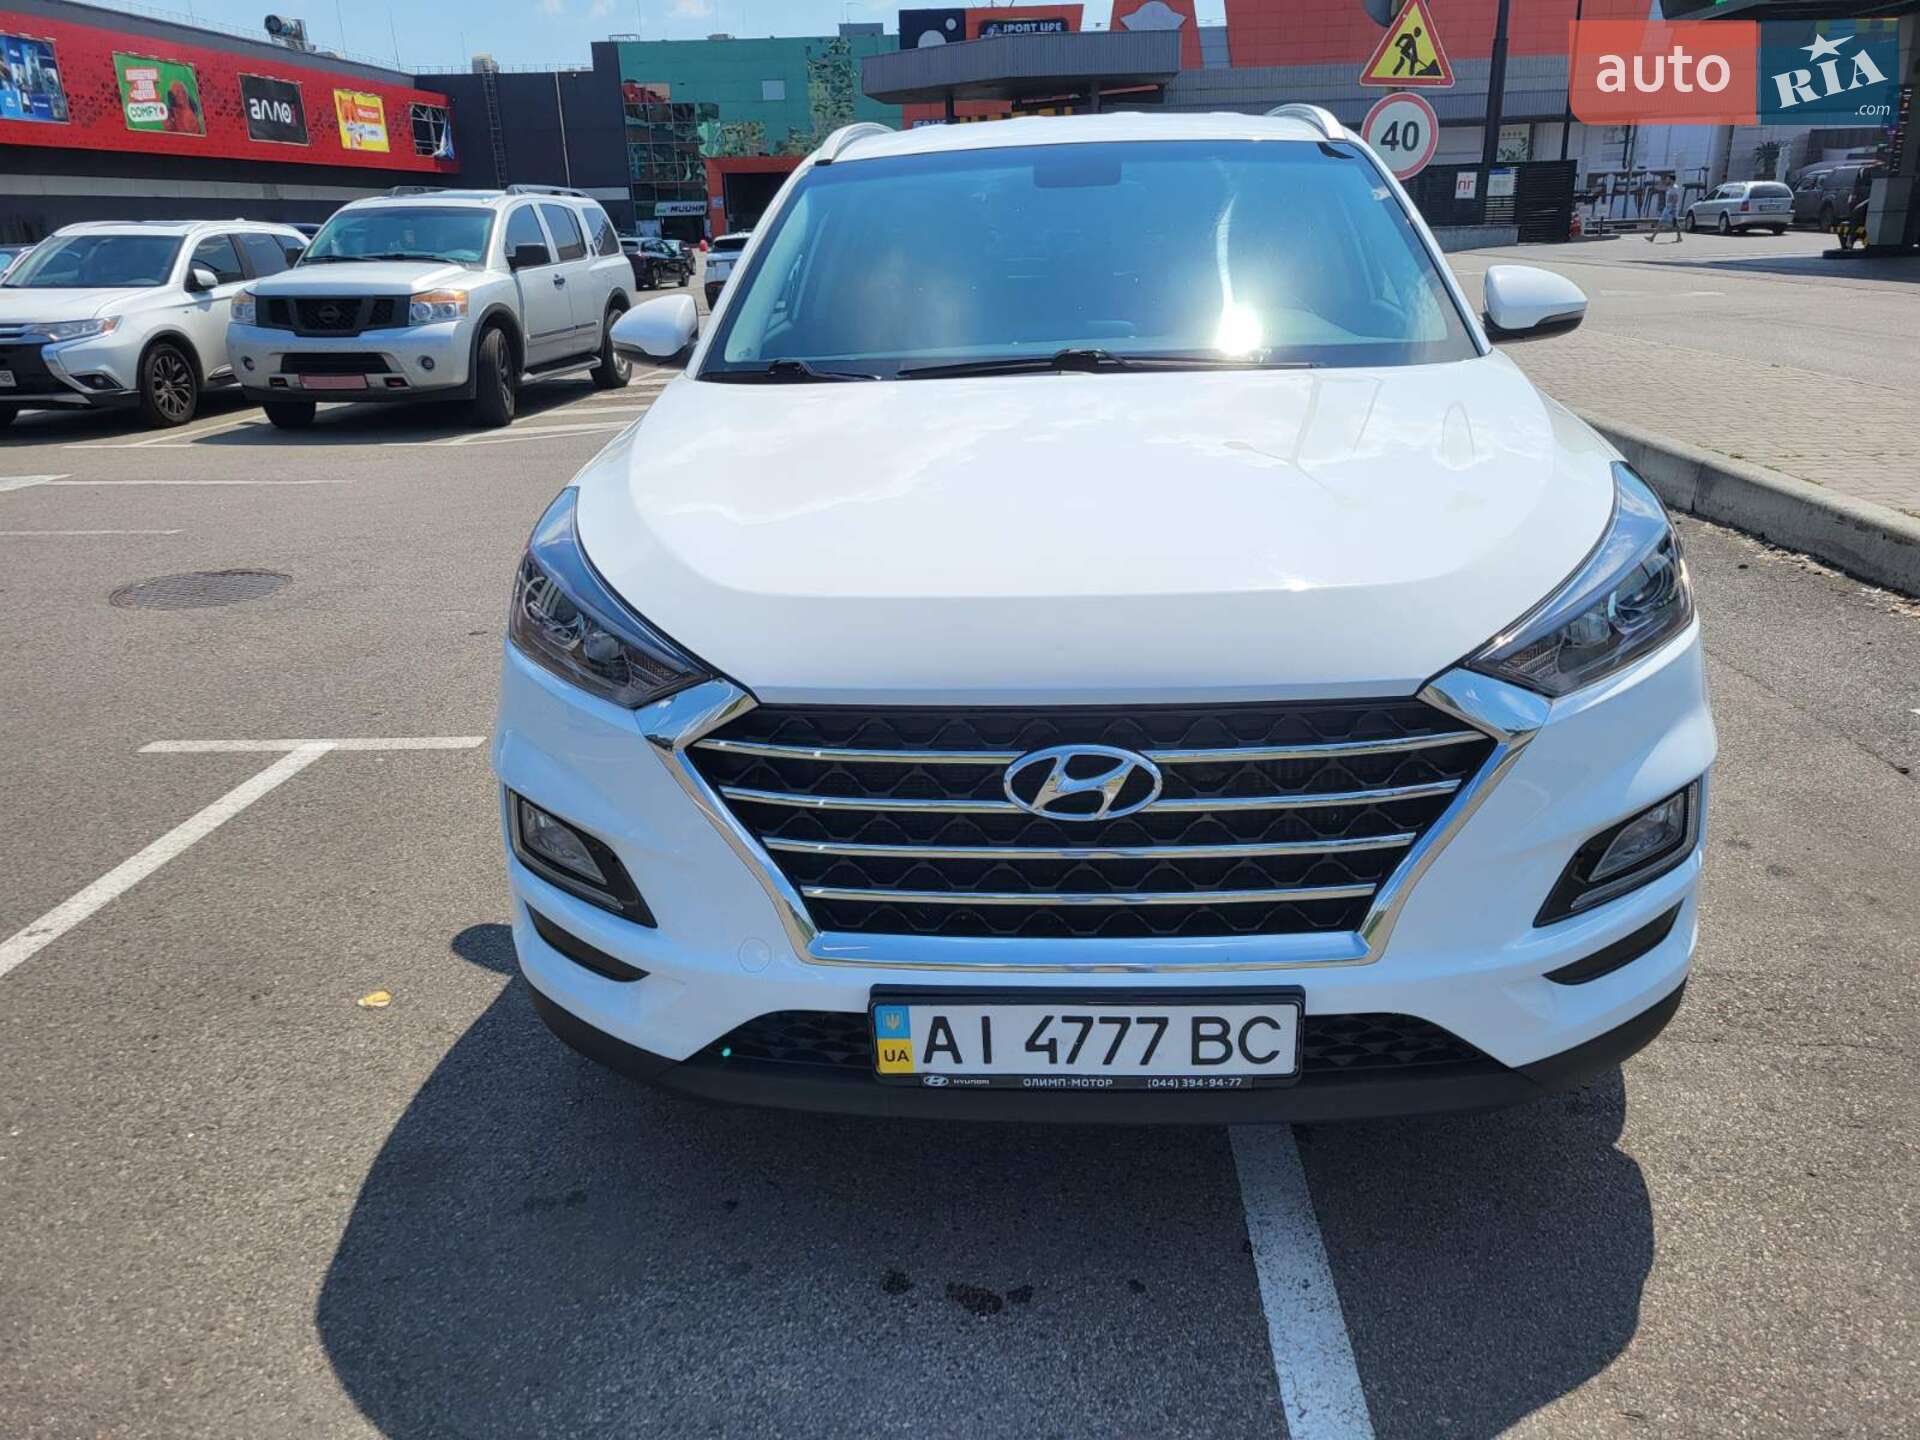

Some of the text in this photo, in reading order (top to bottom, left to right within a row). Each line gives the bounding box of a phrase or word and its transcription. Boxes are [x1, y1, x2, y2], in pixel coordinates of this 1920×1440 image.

[1003, 23, 1037, 33] SPORT
[1380, 121, 1420, 151] 40
[923, 1015, 1281, 1065] AI 4777 BC
[884, 1050, 910, 1062] UA
[1148, 1078, 1242, 1088] (044) 394-94-77
